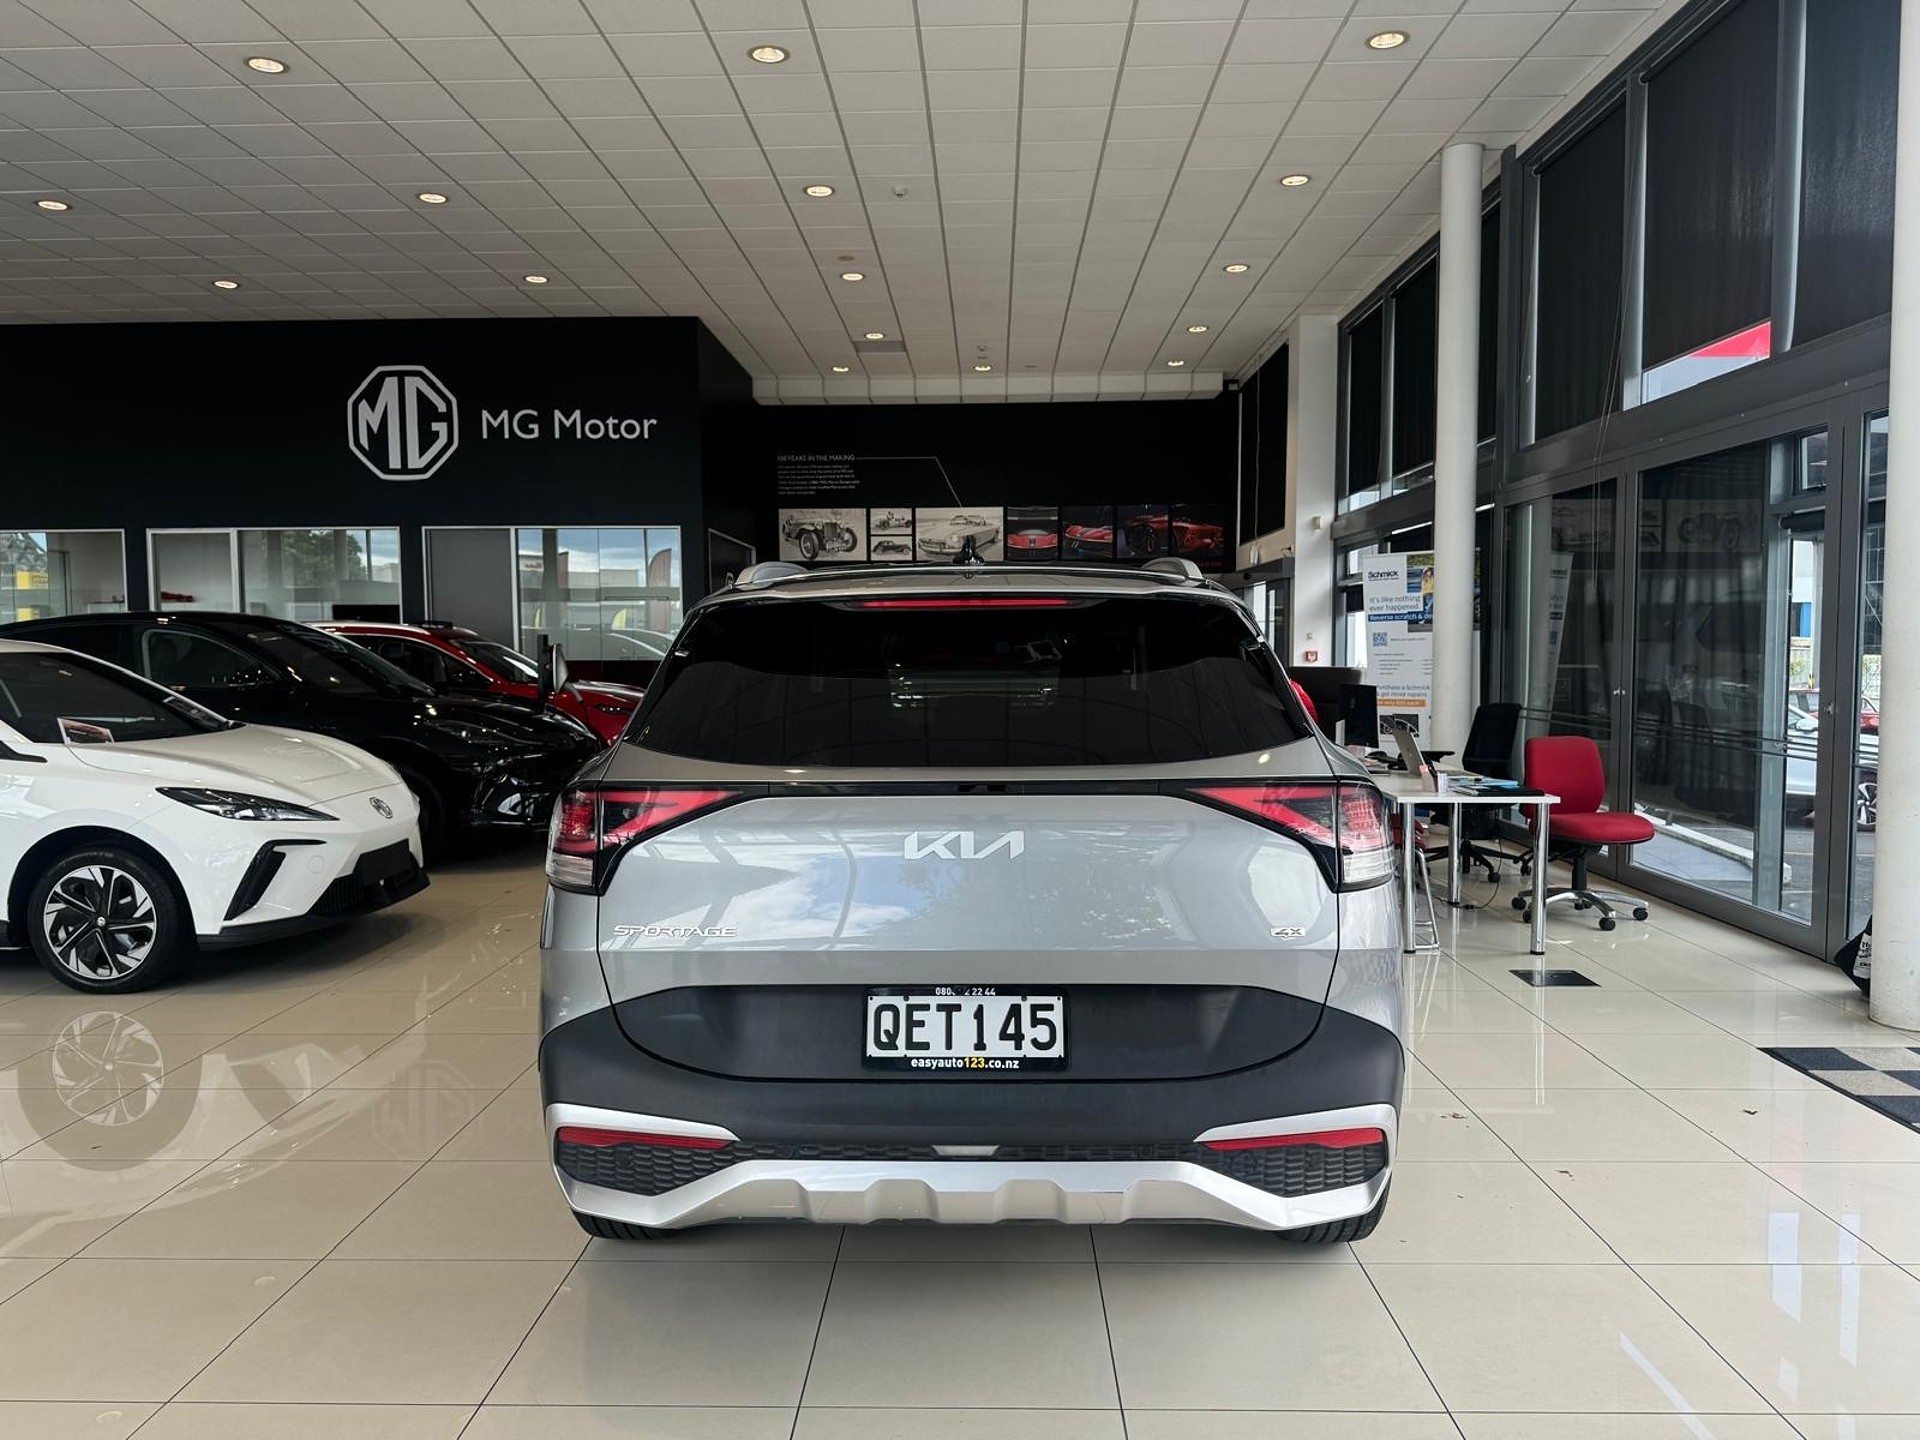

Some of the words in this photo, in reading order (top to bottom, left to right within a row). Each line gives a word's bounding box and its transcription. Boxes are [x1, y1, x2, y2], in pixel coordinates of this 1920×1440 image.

[353, 371, 454, 475] MG
[482, 410, 540, 440] MG
[554, 409, 658, 440] Motor
[1368, 571, 1399, 579] Schmick
[613, 924, 737, 938] SPORTAGE
[873, 1003, 1058, 1052] QET145
[911, 1057, 1020, 1070] easyauto123.co.nz
